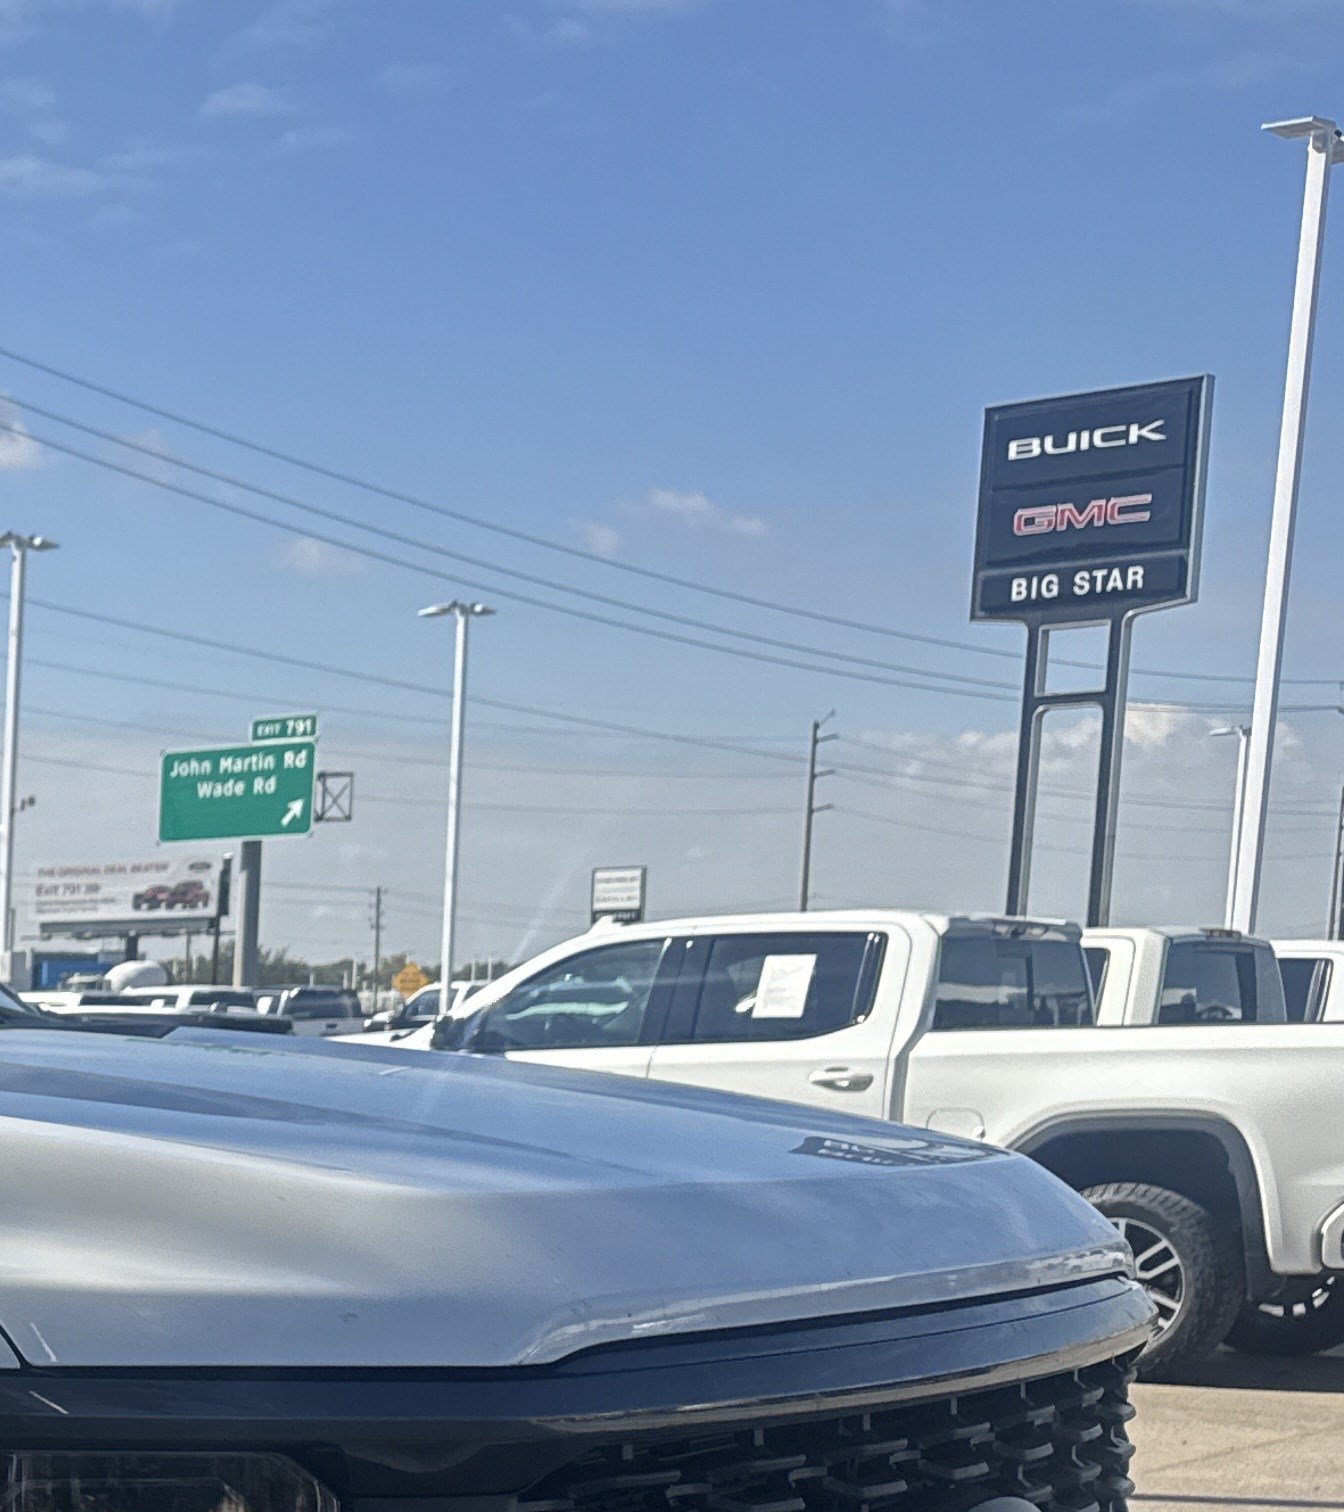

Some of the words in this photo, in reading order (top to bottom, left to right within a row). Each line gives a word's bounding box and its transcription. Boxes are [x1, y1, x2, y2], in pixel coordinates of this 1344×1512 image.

[1007, 419, 1167, 461] BUICK
[1013, 493, 1153, 537] GMC
[1011, 574, 1060, 602] BIG
[1072, 565, 1144, 596] STAR
[286, 718, 312, 737] 791
[169, 758, 212, 778] John
[219, 751, 276, 775] Martin
[283, 748, 308, 770] Rd
[196, 778, 246, 800] Wade
[253, 775, 277, 796] Rd
